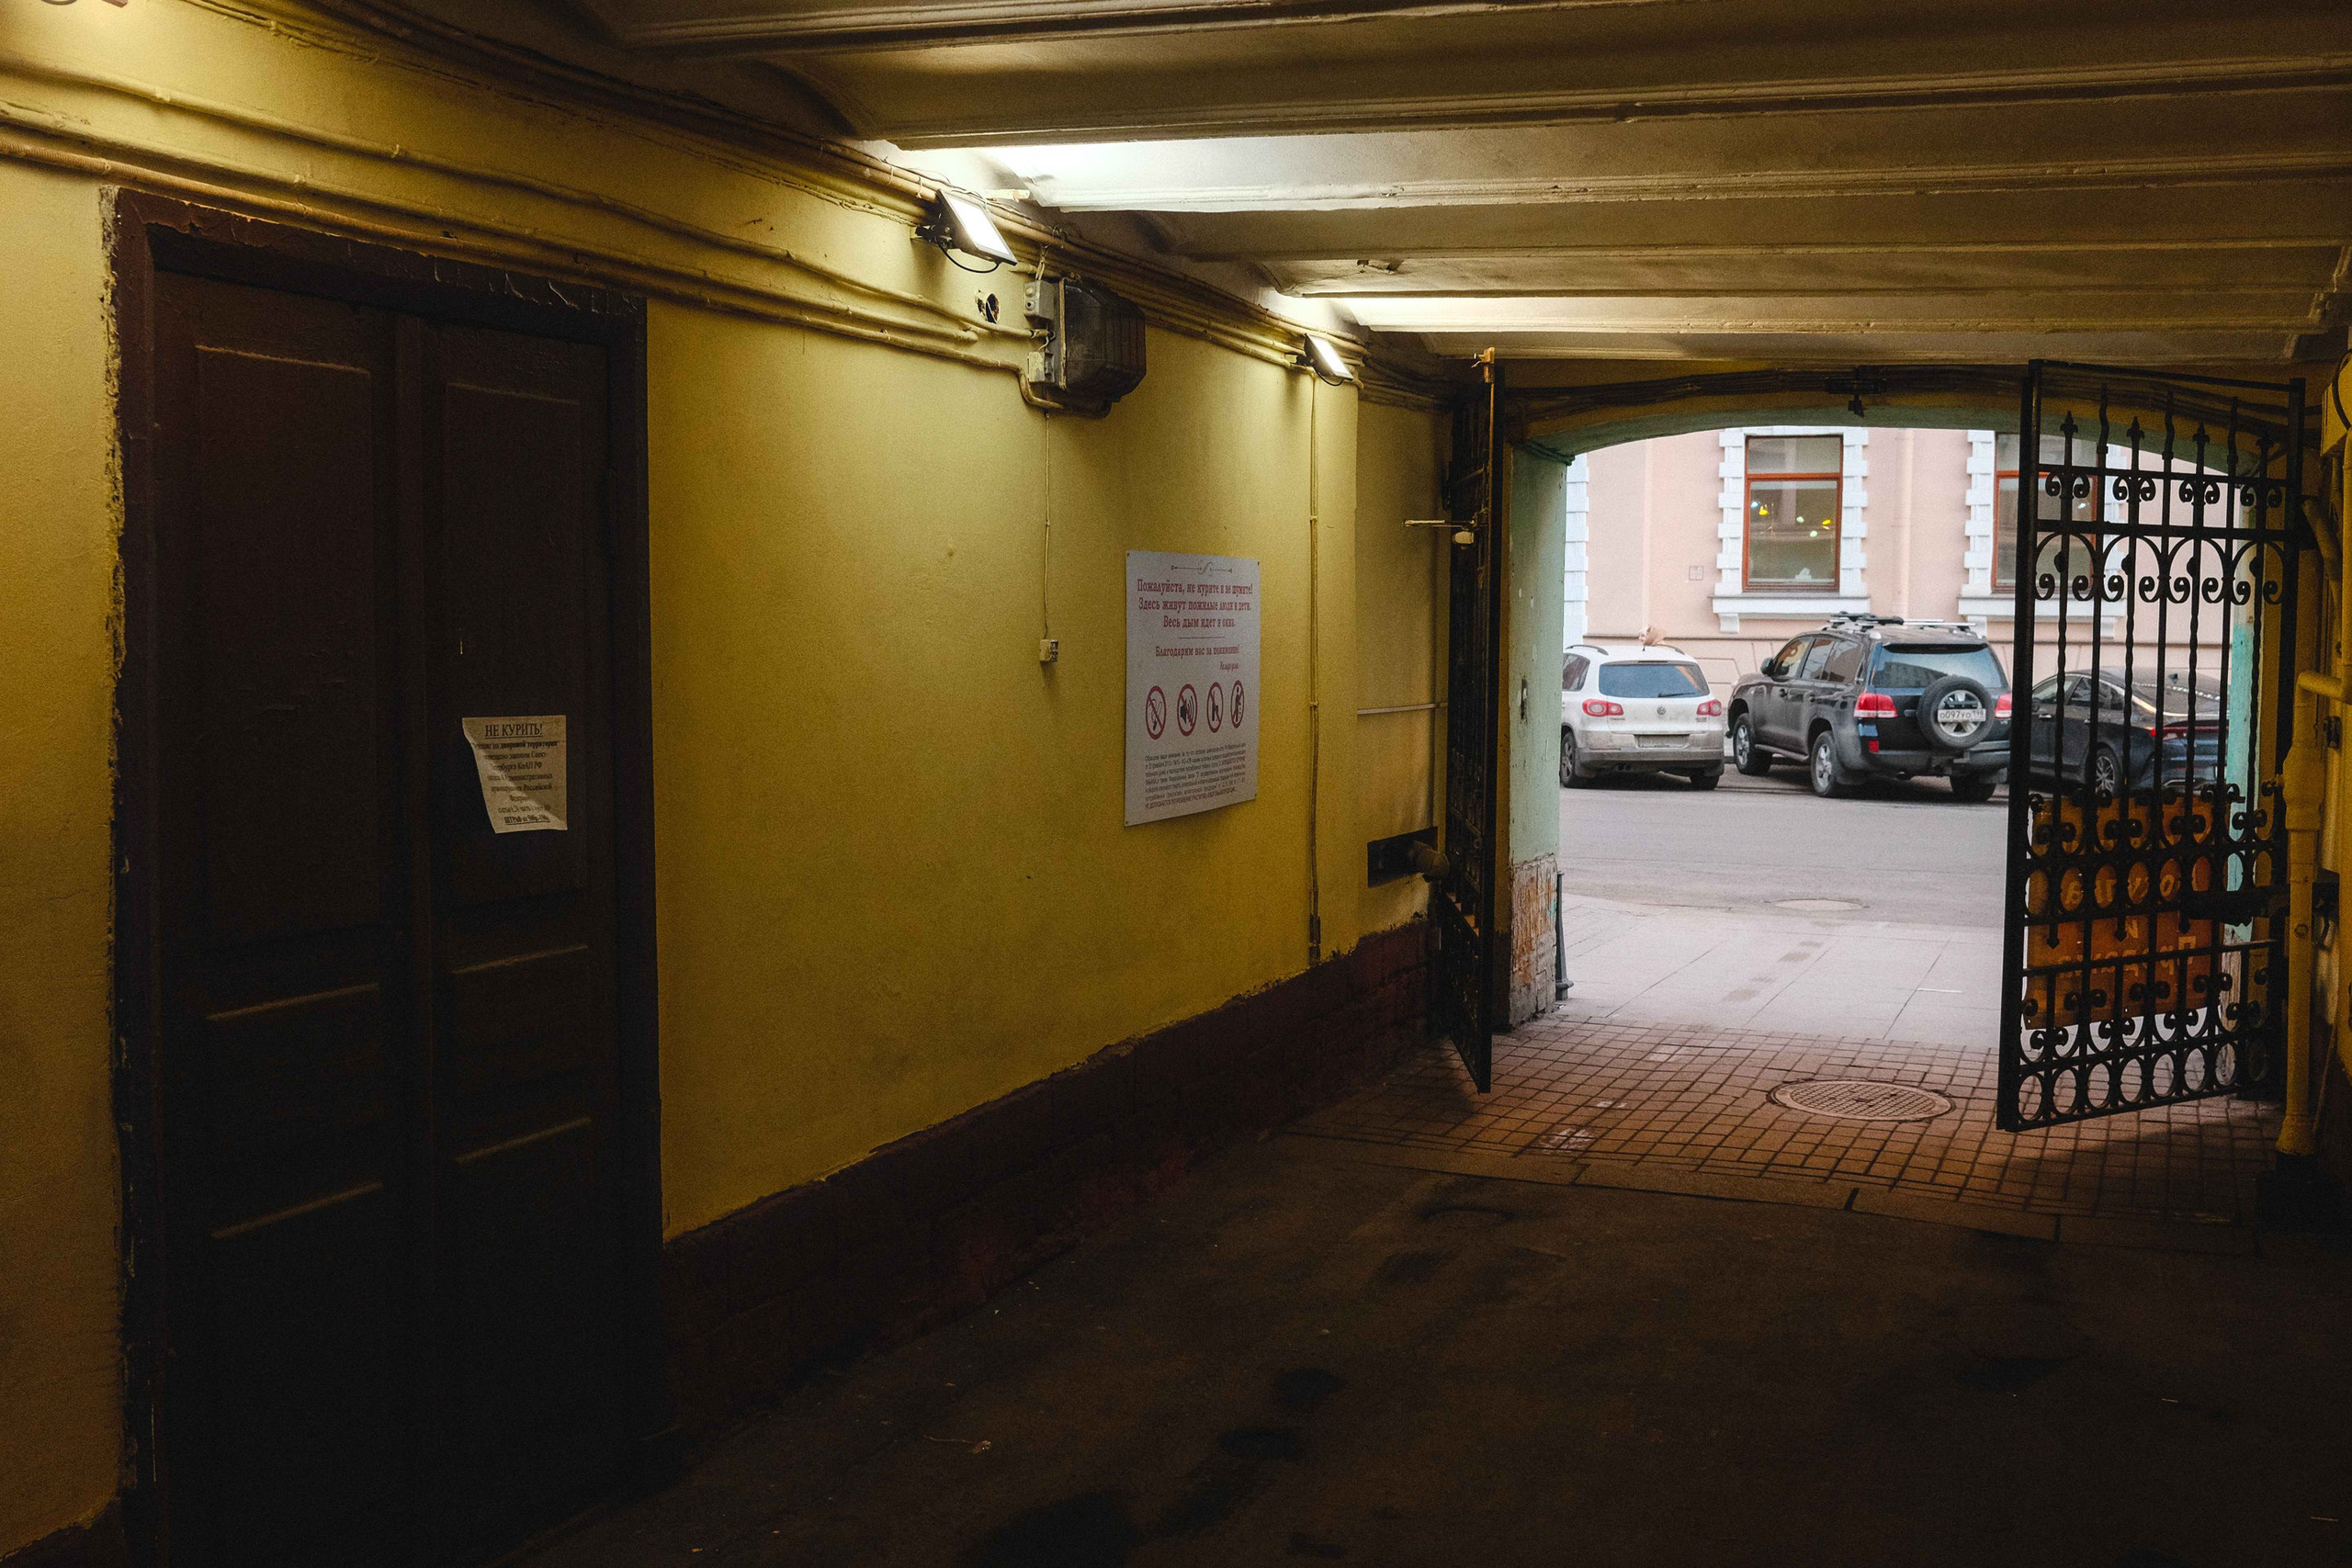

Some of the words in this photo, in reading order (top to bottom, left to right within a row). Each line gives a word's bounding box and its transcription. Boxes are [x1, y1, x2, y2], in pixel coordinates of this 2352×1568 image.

[1137, 579, 1185, 595] Пожалуйста,
[1187, 583, 1195, 593] не
[1197, 584, 1219, 597] курите
[1138, 598, 1160, 611] Здесь
[1162, 601, 1186, 614] живут
[1188, 601, 1218, 611] пожилые
[1163, 615, 1181, 628] Весь
[1182, 618, 1199, 628] дым
[1201, 618, 1216, 628] идет
[1156, 646, 1193, 659] Благодарим
[485, 724, 499, 737] НЕ
[502, 723, 543, 737] КУРИТЬ!
